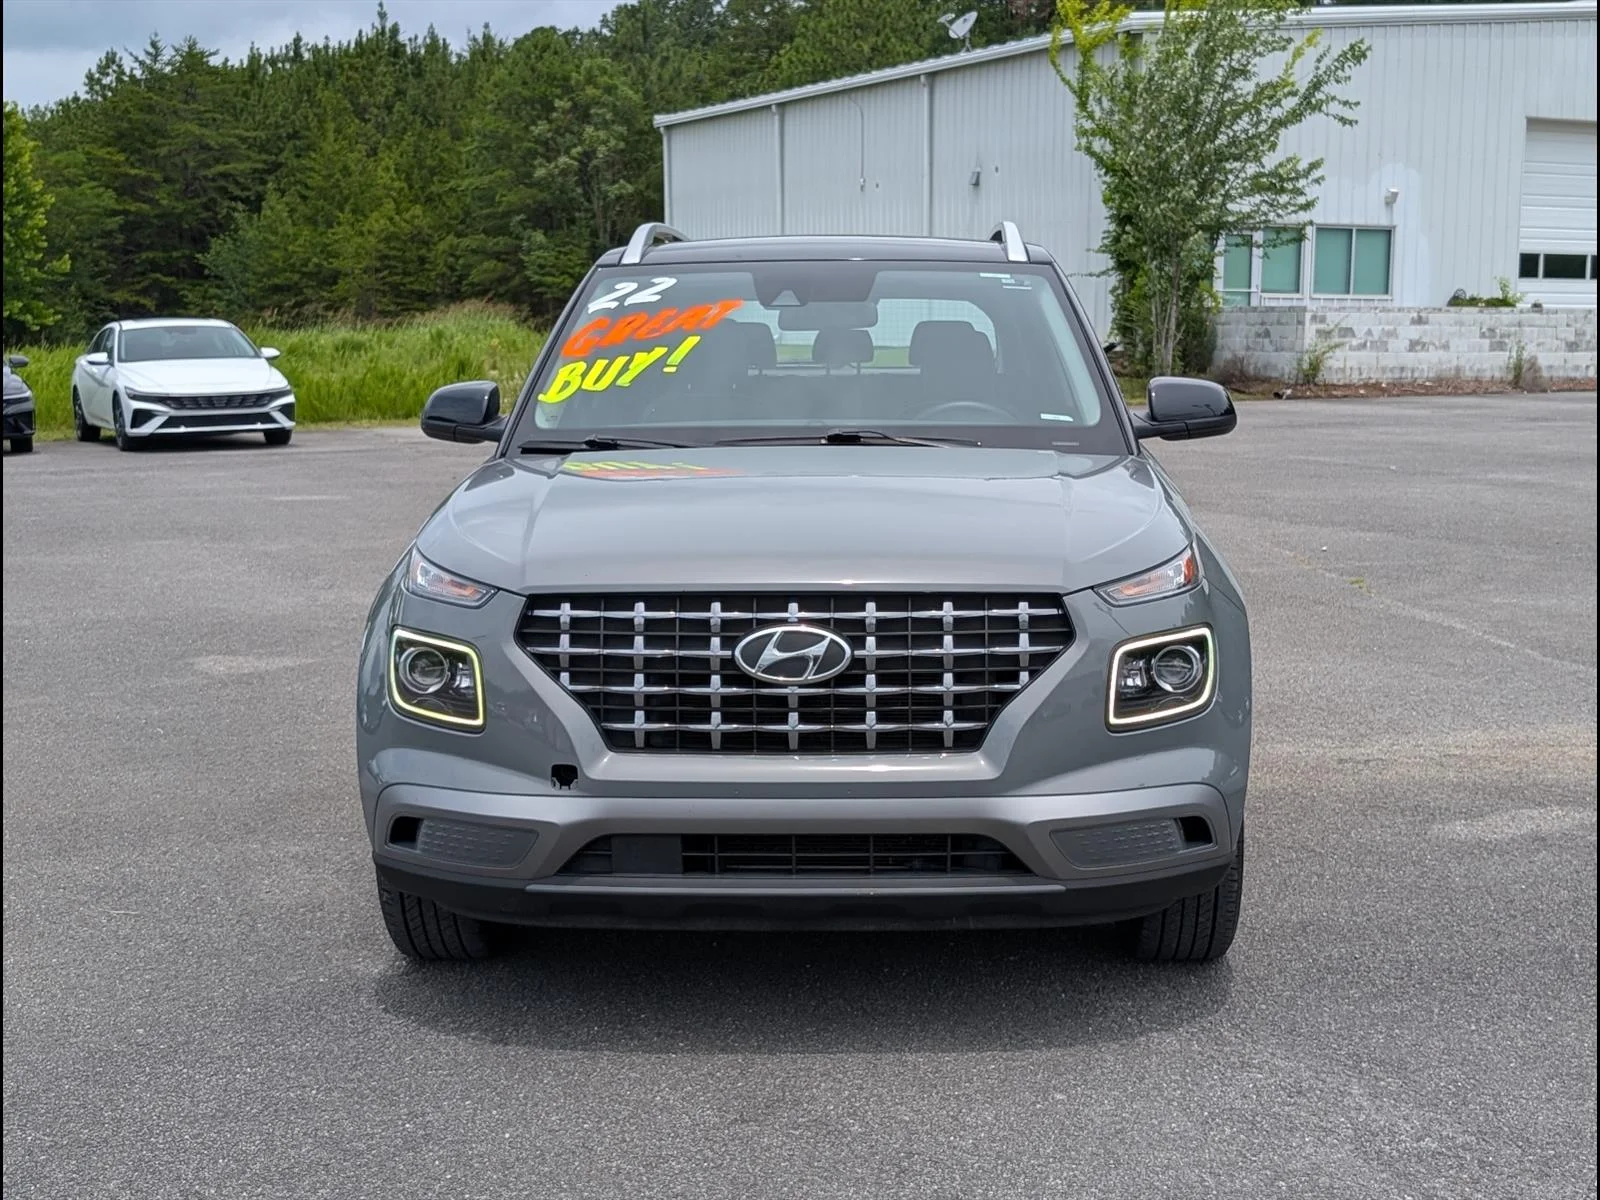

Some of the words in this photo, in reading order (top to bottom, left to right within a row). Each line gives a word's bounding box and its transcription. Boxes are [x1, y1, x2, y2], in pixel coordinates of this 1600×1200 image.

[587, 277, 677, 314] 22
[560, 298, 743, 358] GREAT
[537, 335, 701, 403] BUY!
